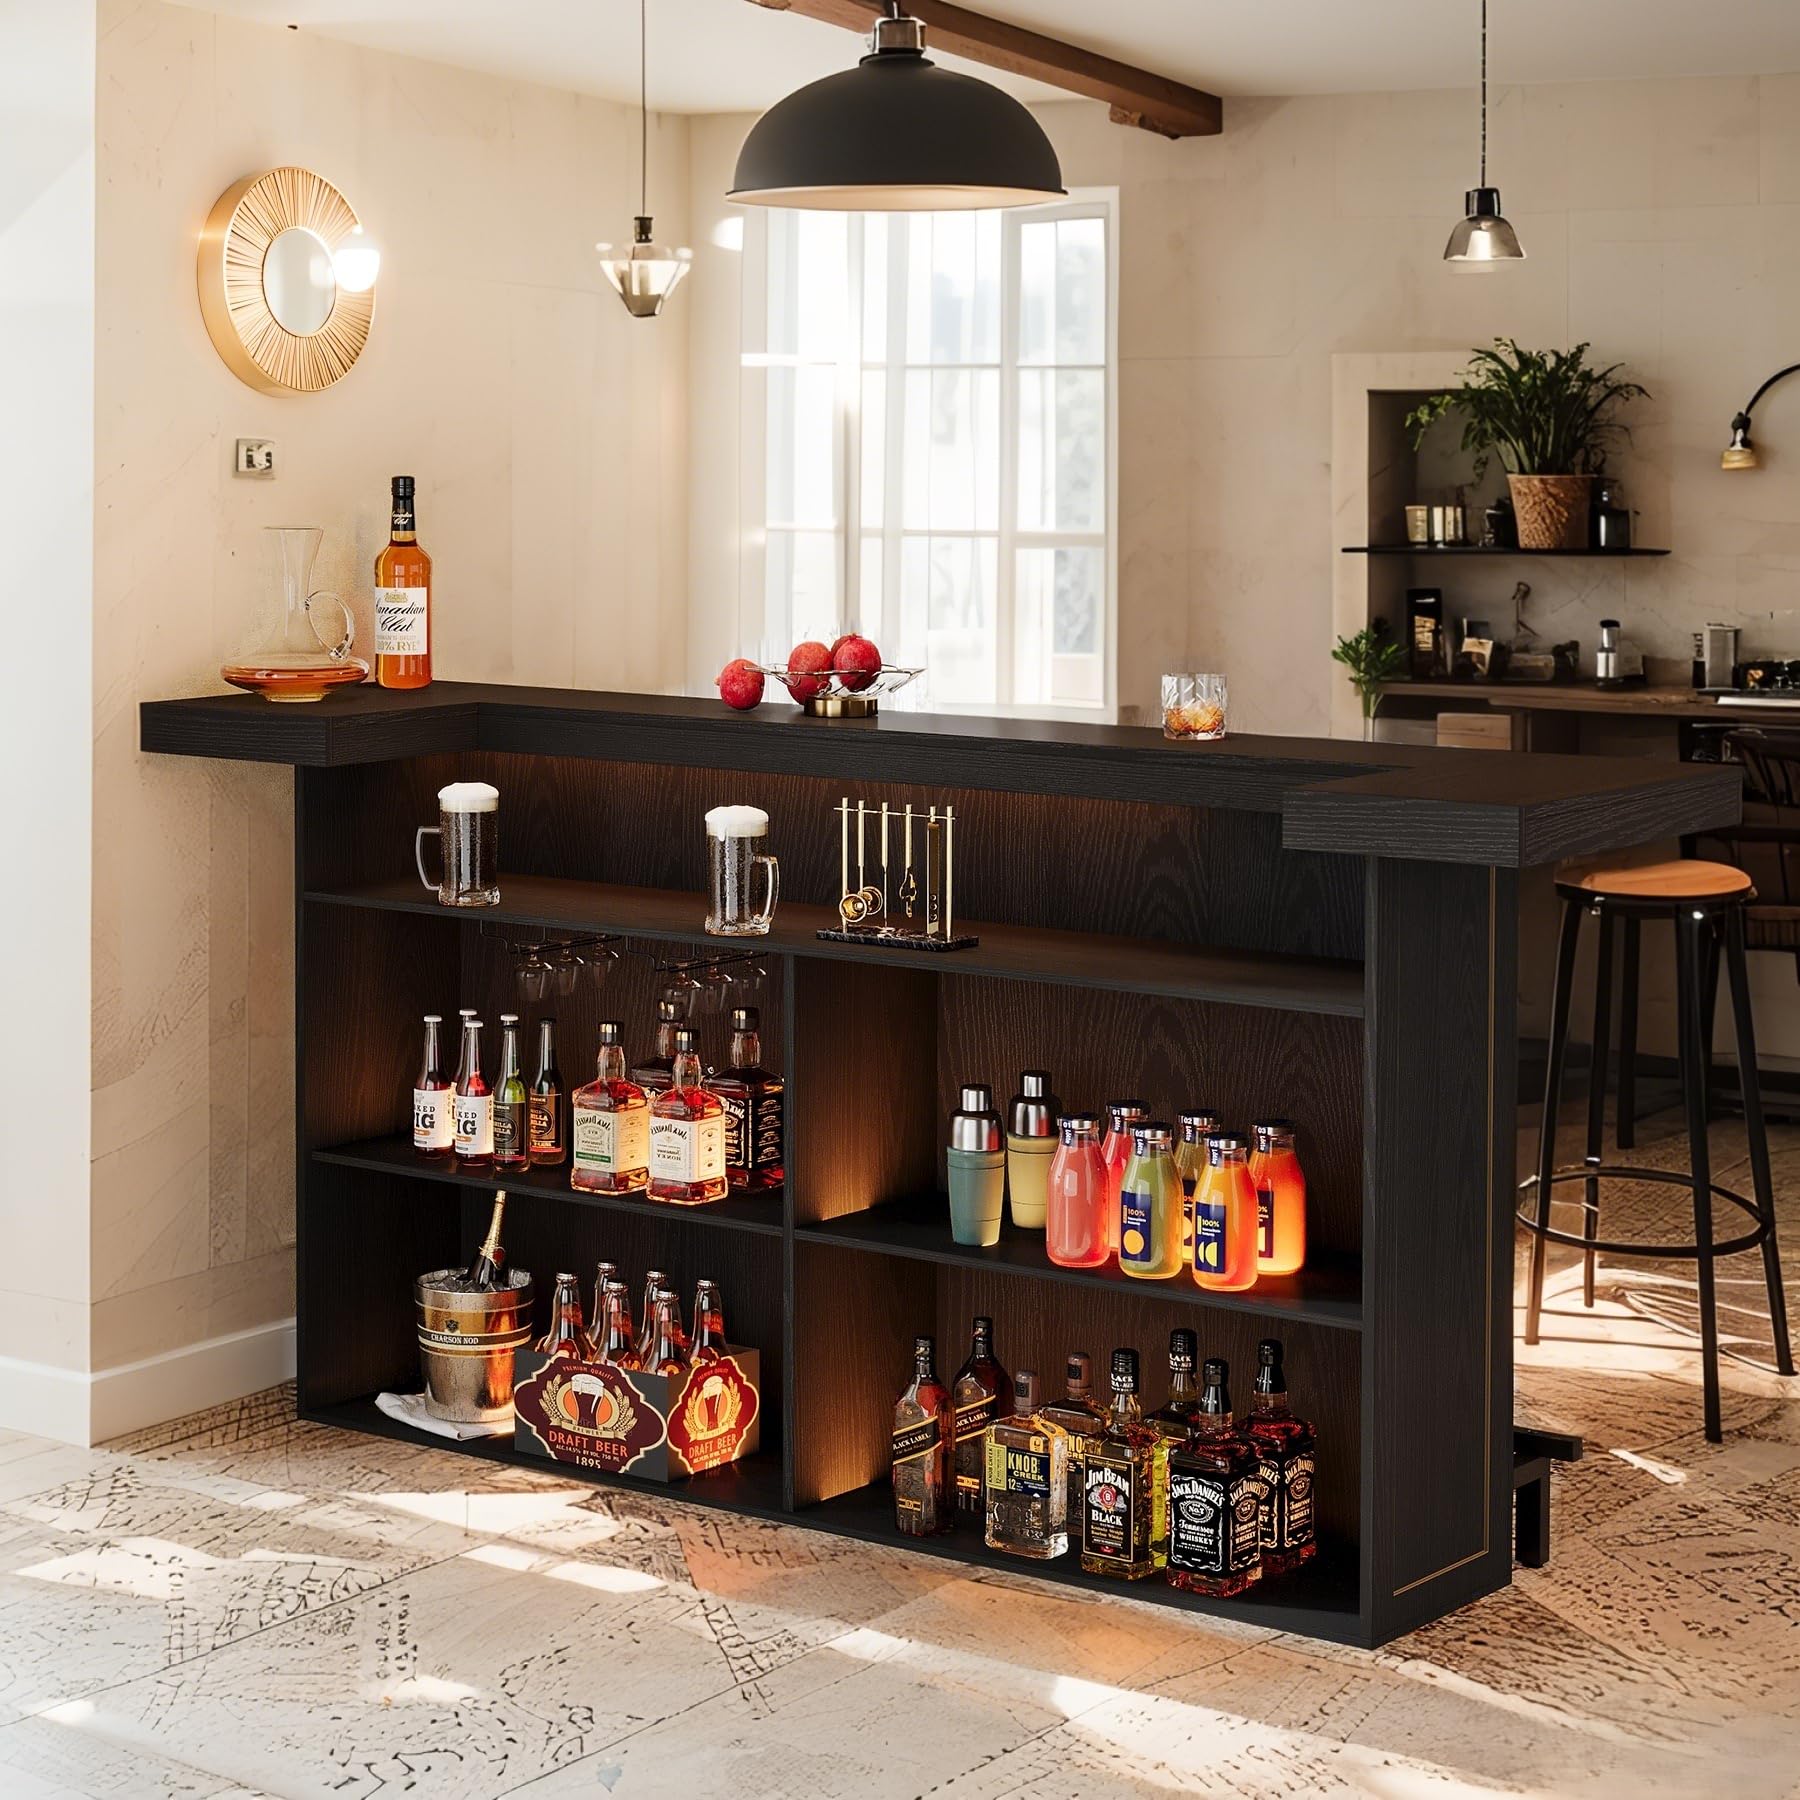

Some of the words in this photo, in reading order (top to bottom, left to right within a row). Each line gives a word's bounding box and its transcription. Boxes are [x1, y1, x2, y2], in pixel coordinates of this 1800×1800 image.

[379, 615, 416, 632] Club
[1127, 1208, 1145, 1217] 100%
[1202, 1219, 1220, 1228] 100%
[463, 1337, 479, 1345] NOD
[548, 1430, 589, 1449] DRAFT
[596, 1440, 628, 1458] BEER
[688, 1440, 714, 1459] DRAFT
[717, 1433, 738, 1450] BEER
[576, 1455, 601, 1469] 1895
[1007, 1452, 1038, 1474] KNOB
[1067, 1451, 1084, 1460] CRE
[1013, 1470, 1044, 1482] CREEK
[1085, 1469, 1104, 1490] JIM
[1104, 1467, 1130, 1498] BEAM
[1285, 1465, 1298, 1485] JACK
[1008, 1478, 1016, 1490] 12
[1171, 1482, 1192, 1499] JACK
[1192, 1480, 1225, 1507] DANIEL'S
[1229, 1486, 1243, 1507] JACK
[1091, 1509, 1123, 1526] BLACK
[1179, 1533, 1214, 1545] WHISKEY
